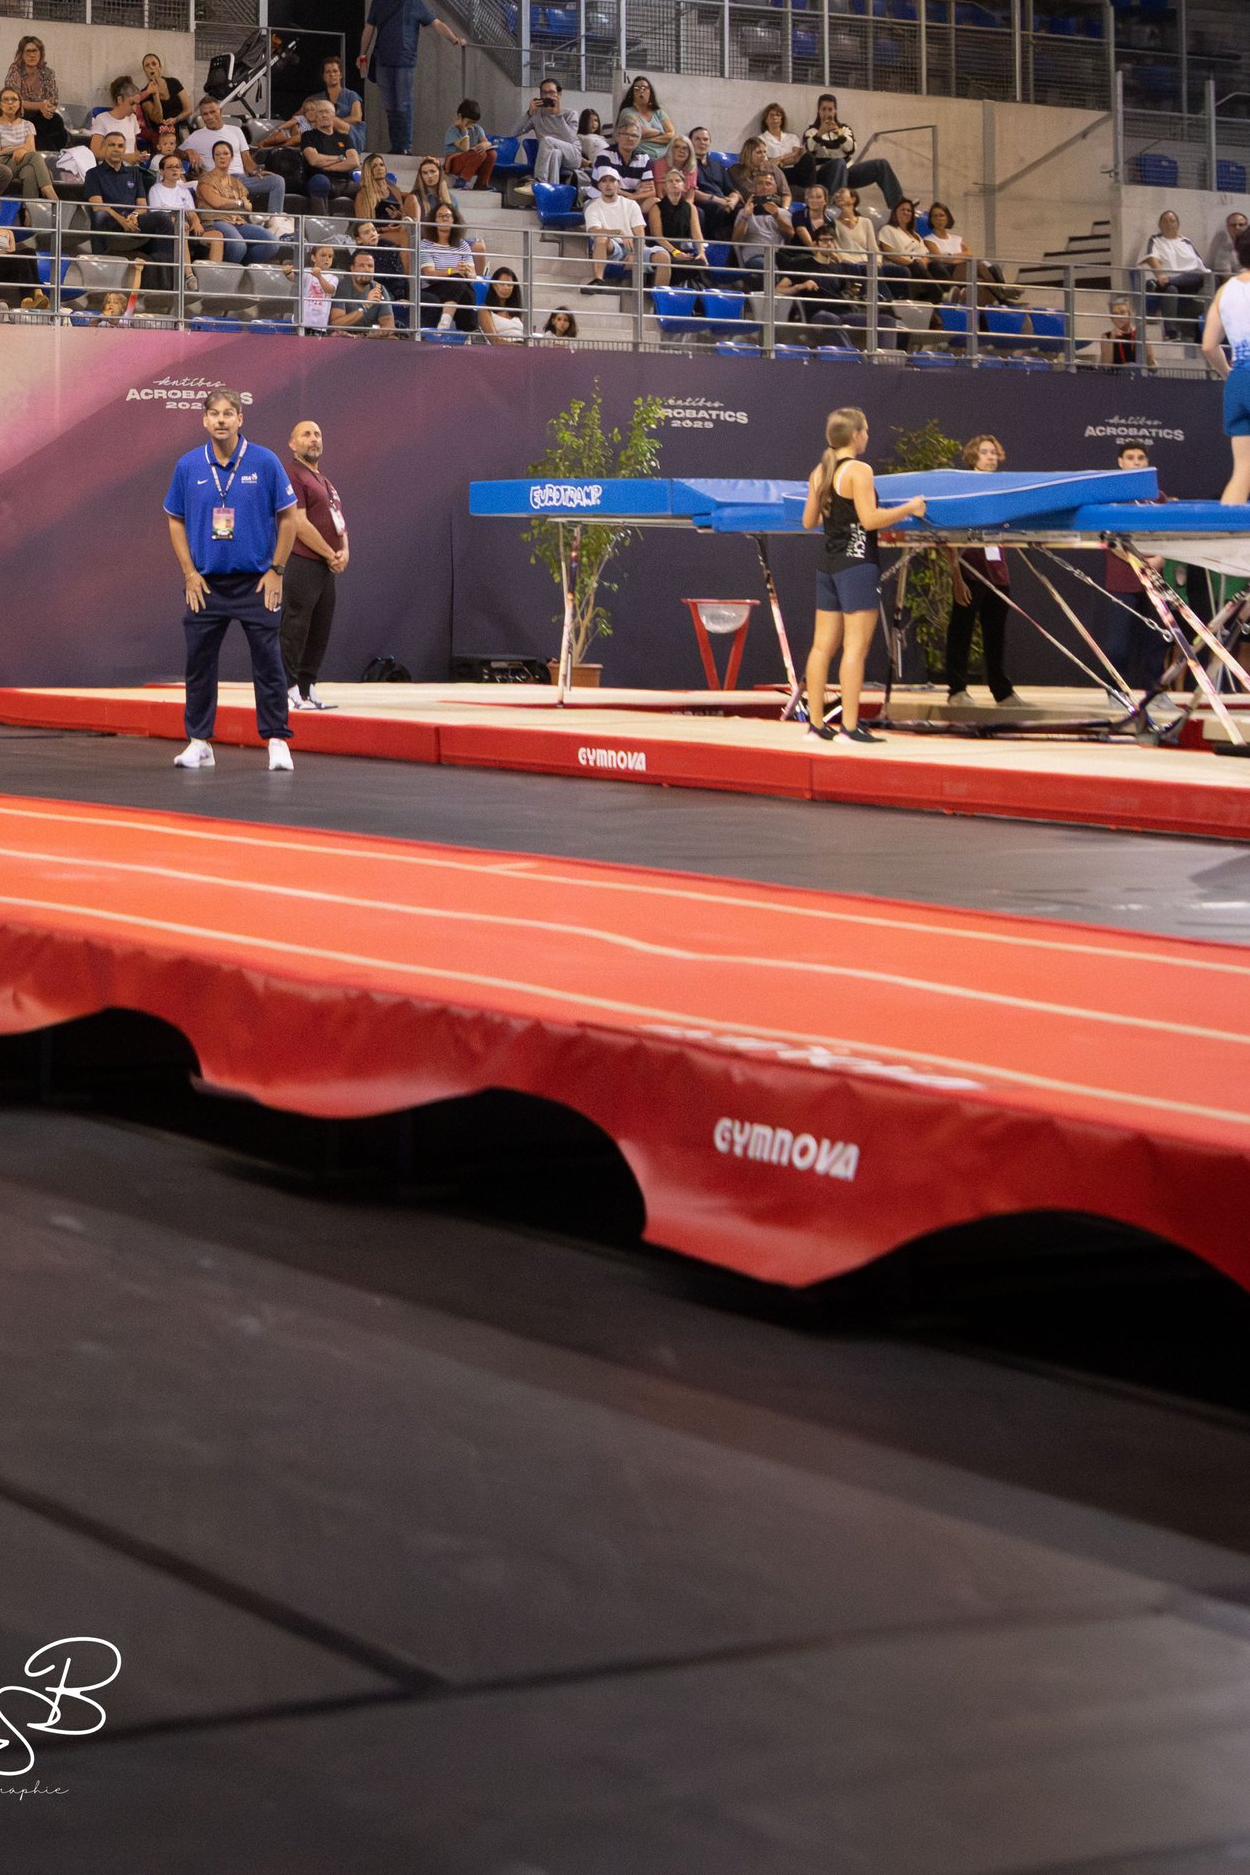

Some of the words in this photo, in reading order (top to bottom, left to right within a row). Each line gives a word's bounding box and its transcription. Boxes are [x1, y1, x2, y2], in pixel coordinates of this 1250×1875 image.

[152, 376, 226, 388] Antibes
[125, 388, 254, 406] ACROBAS
[165, 401, 207, 410] 202
[661, 408, 749, 424] ROBATICS
[670, 420, 714, 429] 2025
[1084, 425, 1185, 442] ACROBATICS
[577, 746, 647, 772] GYMNOVA
[713, 1115, 861, 1183] GYMNOVA
